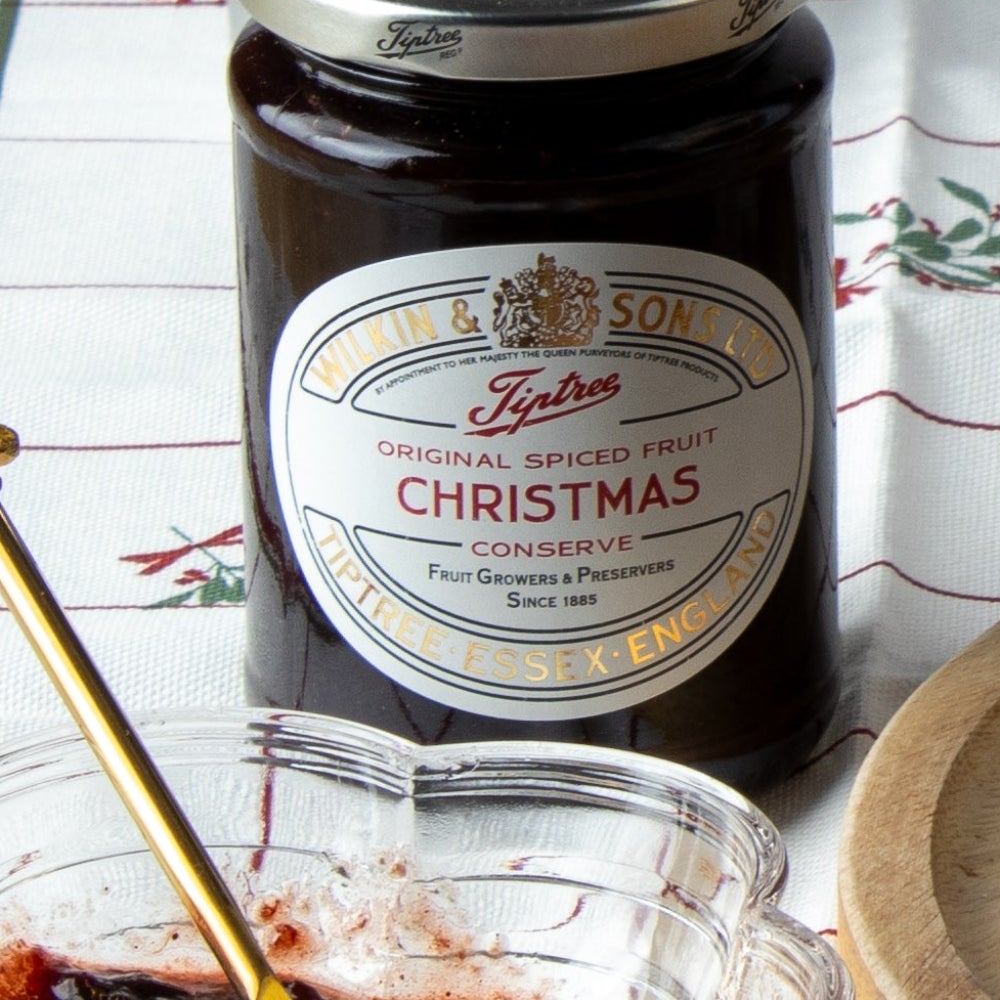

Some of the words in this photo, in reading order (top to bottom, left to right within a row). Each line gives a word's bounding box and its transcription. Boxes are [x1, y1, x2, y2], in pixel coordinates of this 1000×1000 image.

[375, 20, 463, 60] Tiptree
[309, 301, 439, 393] WILKIN
[449, 298, 481, 334] &
[608, 291, 720, 343] SONS
[723, 319, 777, 382] LTD
[386, 363, 442, 389] APPOINTMENT
[443, 361, 456, 370] TO
[459, 356, 477, 366] HER
[480, 352, 520, 363] MAJESTY
[521, 350, 540, 358] THE
[542, 349, 577, 358] QUEEN
[578, 349, 632, 358] PURVEYORS
[634, 351, 647, 360] OF
[648, 353, 680, 367] TIPTREE
[680, 361, 720, 383] PRODUCTS
[464, 366, 622, 436] Tiptree
[377, 440, 512, 470] ORIGINAL
[524, 446, 631, 470] SPICED
[643, 427, 719, 459] FRUIT
[397, 464, 701, 524] CHRISTMAS
[471, 534, 633, 559] CONSERVE
[563, 571, 574, 584] &
[626, 507, 778, 665] ENGLAND
[563, 593, 598, 608] 1885
